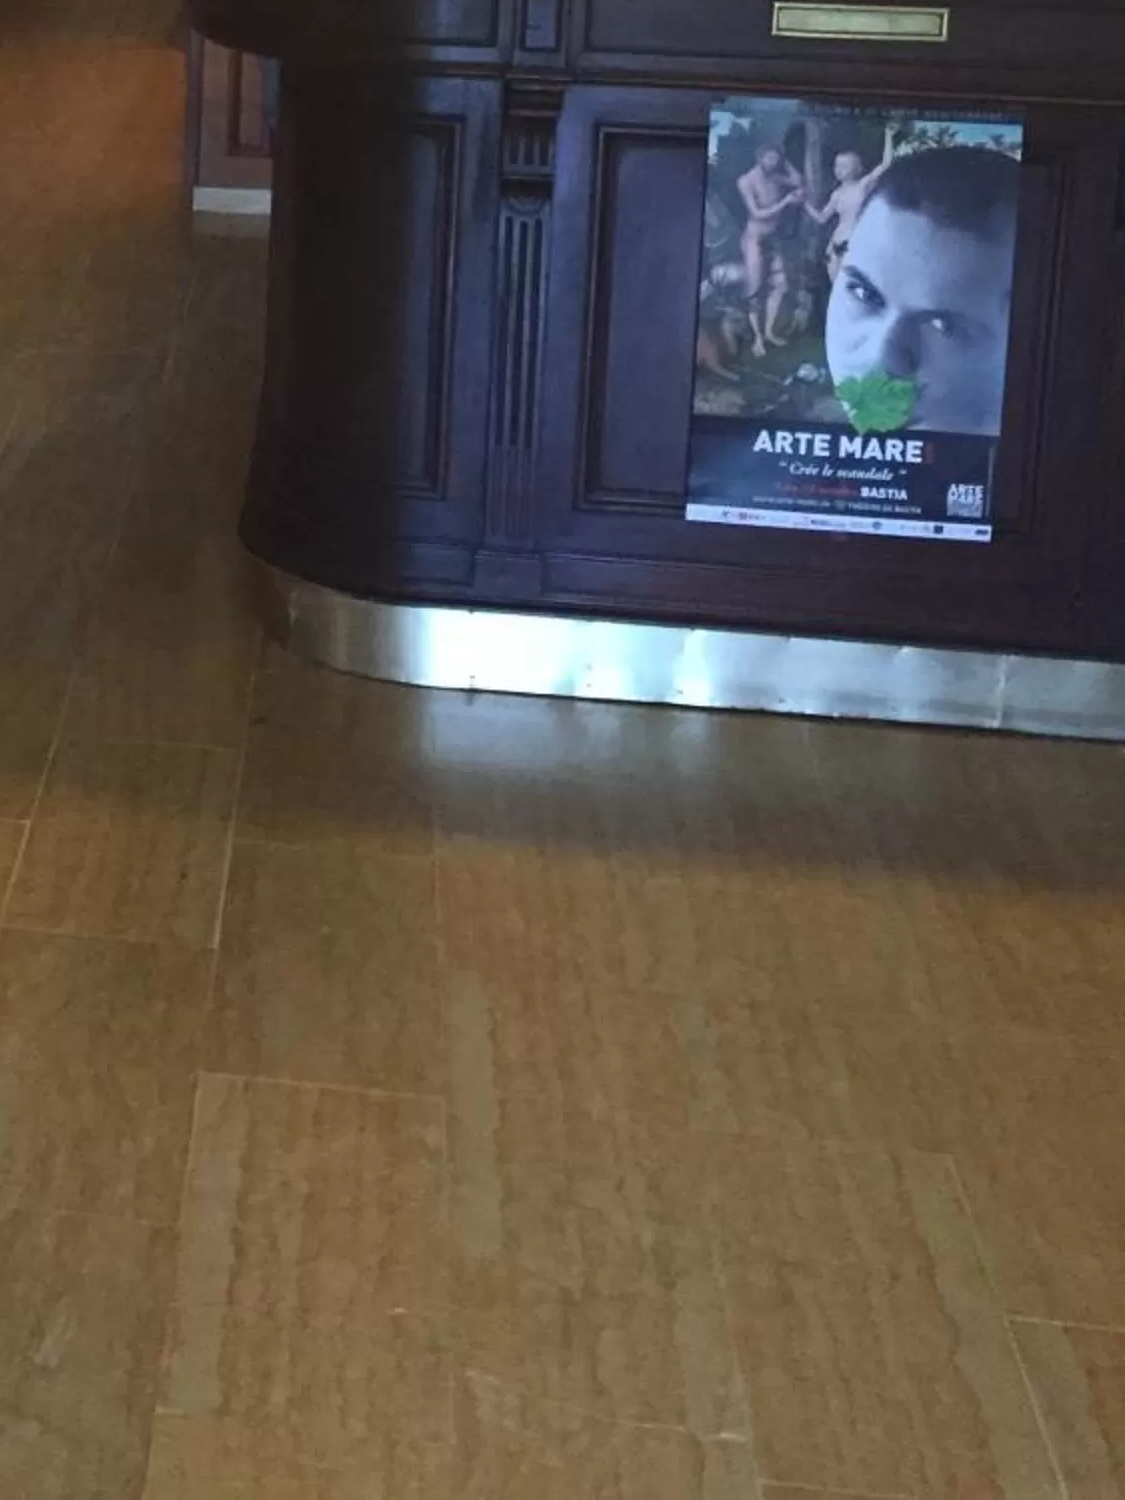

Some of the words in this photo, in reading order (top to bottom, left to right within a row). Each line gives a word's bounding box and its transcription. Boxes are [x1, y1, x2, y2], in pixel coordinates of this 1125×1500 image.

[753, 429, 832, 457] ARTE
[838, 435, 924, 464] MARE
[860, 486, 908, 500] BASTIA
